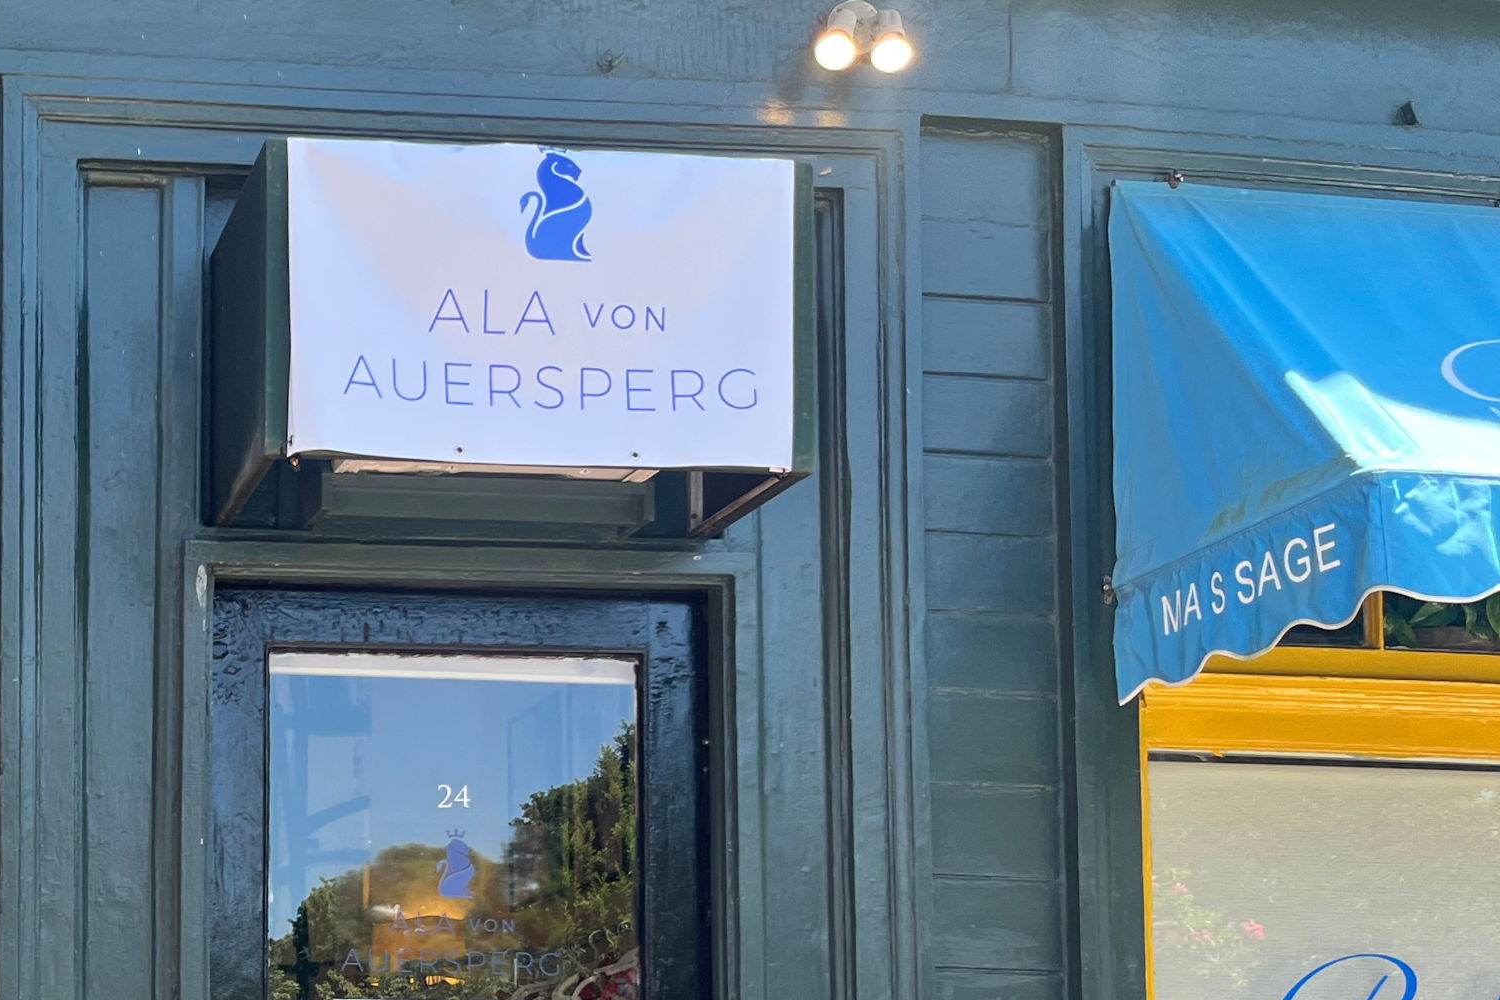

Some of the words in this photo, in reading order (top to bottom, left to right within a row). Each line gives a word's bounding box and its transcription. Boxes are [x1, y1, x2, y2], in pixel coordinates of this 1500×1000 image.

[428, 288, 555, 336] ALA
[583, 302, 666, 332] VON
[343, 354, 759, 412] AUERSPERG
[1160, 522, 1341, 636] MASSAGE
[436, 784, 471, 809] 24
[389, 911, 456, 936] ALA
[468, 919, 516, 933] VON
[340, 948, 562, 977] AUERSPERG
